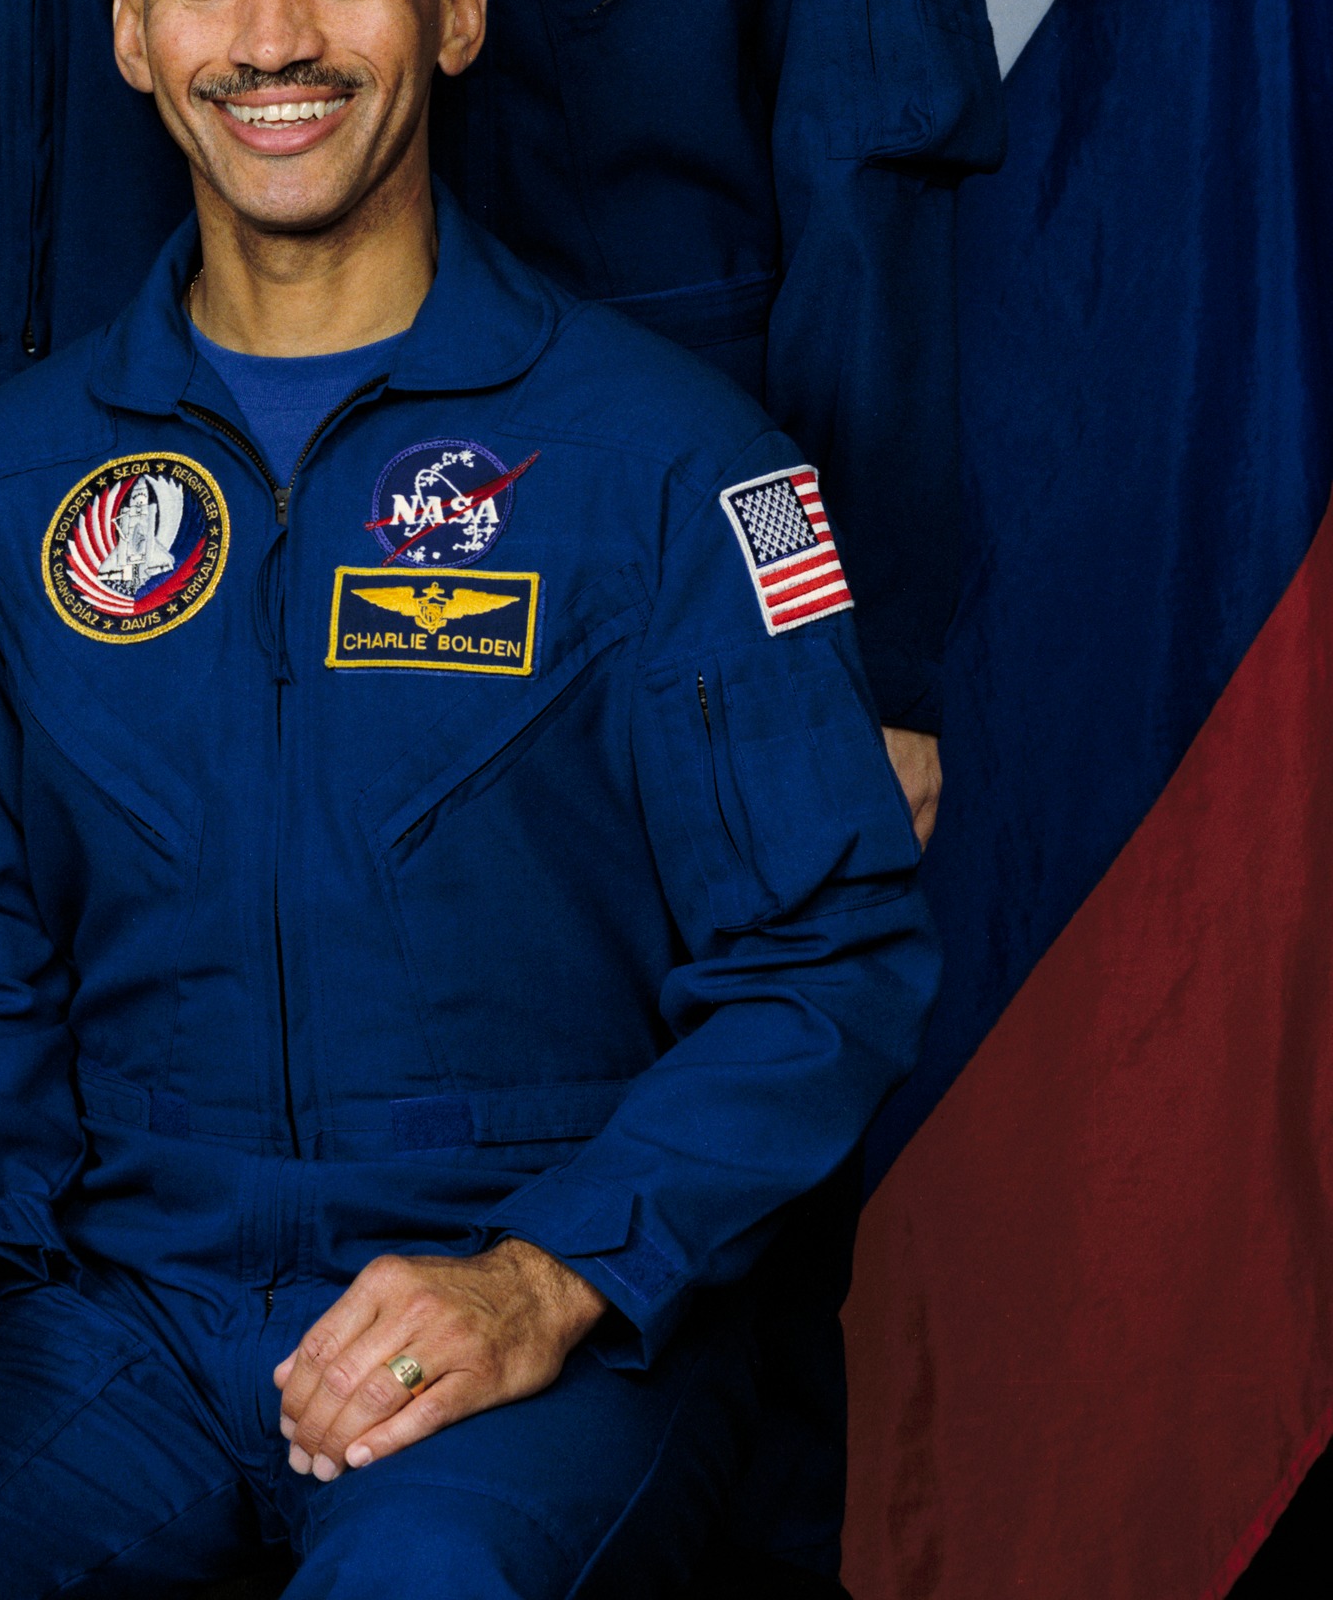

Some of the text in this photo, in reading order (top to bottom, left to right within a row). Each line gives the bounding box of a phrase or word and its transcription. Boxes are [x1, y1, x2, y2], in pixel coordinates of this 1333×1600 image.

[55, 462, 218, 541] BOLDEN SEGA REIGHTLER
[390, 494, 499, 525] NASA
[53, 542, 219, 631] CHANG-DÍAZ DAVIS KRIKALEV
[342, 632, 521, 657] CHARLIE BOLDEN
